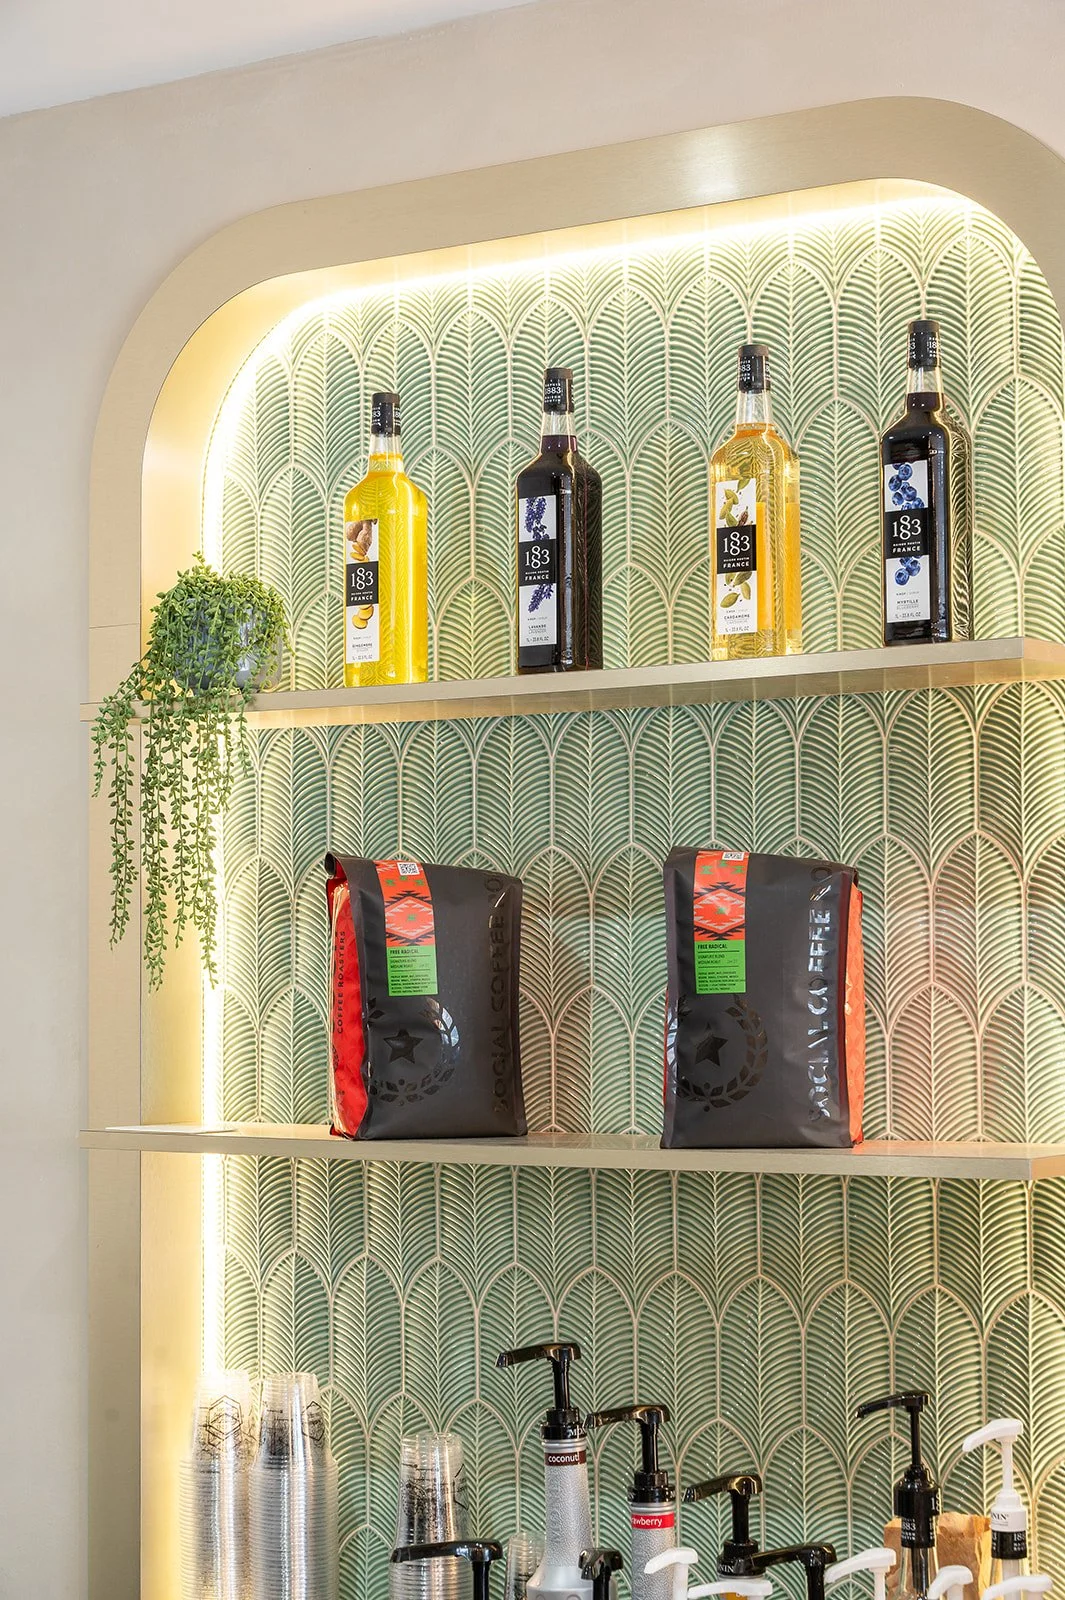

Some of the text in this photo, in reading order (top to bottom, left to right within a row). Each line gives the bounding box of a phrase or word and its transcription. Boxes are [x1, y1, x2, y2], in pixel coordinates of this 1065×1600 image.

[893, 515, 921, 540] 1883
[723, 531, 750, 556] 1883
[525, 545, 550, 569] 1883
[351, 567, 374, 590] 1883
[337, 931, 345, 988] ROASTERS
[489, 915, 506, 1012] COFFEE
[808, 909, 830, 1016] COFFEE
[491, 1023, 508, 1113] SOCIAL
[808, 1021, 830, 1121] SOCIAL
[548, 1454, 579, 1463] coconut
[991, 1512, 1007, 1520] NIN
